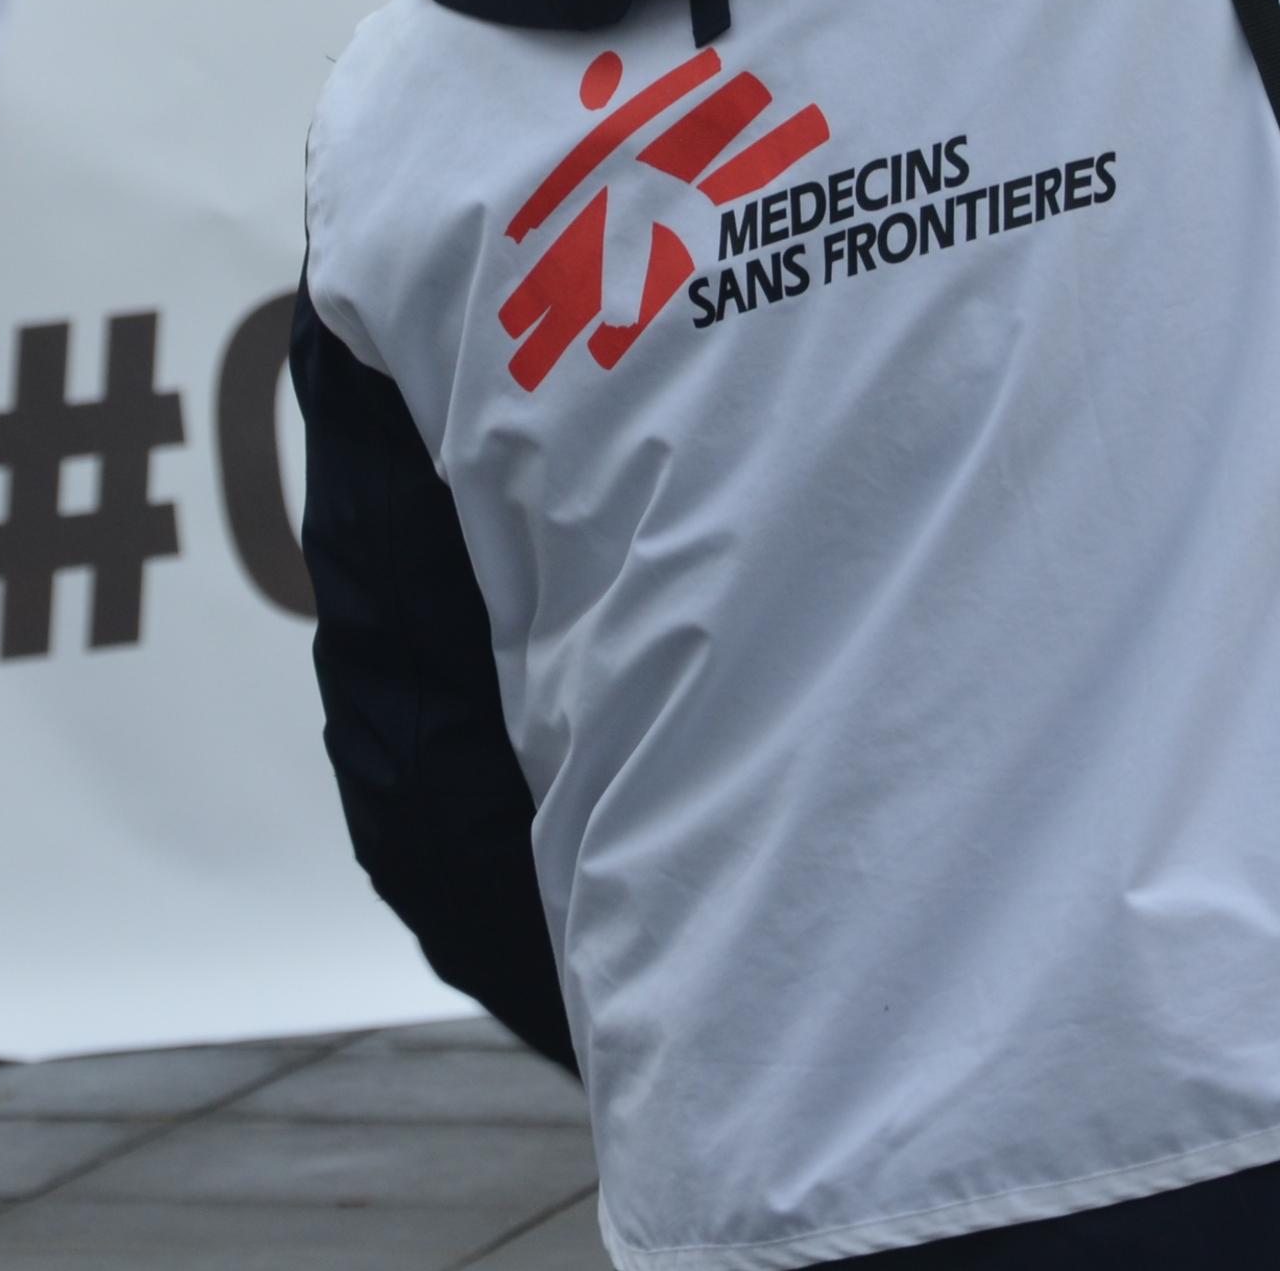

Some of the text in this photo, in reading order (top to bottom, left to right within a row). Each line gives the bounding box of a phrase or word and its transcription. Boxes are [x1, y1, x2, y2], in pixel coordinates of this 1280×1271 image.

[688, 151, 1118, 329] SANS FRONTIERES
[718, 135, 970, 262] MEDECINS
